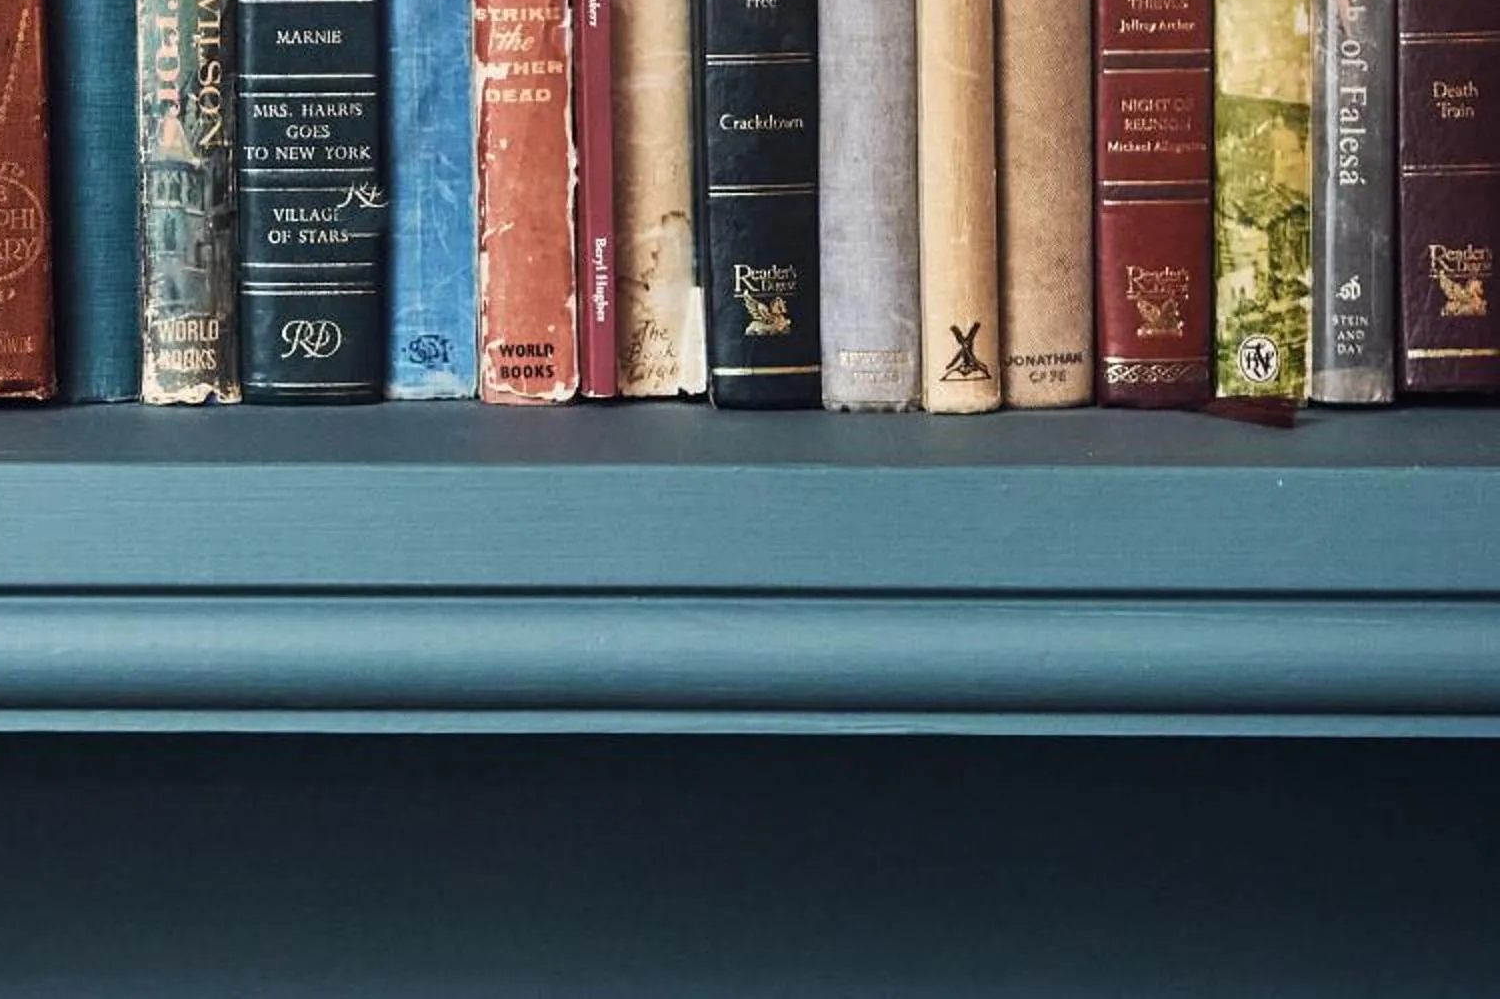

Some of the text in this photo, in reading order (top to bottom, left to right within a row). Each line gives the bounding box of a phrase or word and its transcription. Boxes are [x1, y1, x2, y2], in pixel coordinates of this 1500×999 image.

[276, 31, 342, 44] MARNIE
[485, 89, 551, 102] DEAD
[1433, 82, 1478, 99] Death
[253, 104, 362, 118] MRS. HARRIS
[1437, 102, 1474, 118] Train
[720, 114, 803, 130] Crackdown
[286, 124, 330, 138] GOES
[1339, 86, 1367, 185] Falesá
[244, 145, 372, 160] TO NEW YORK
[268, 230, 349, 244] OF STARS
[592, 238, 606, 272] Beryl
[1332, 315, 1369, 326] STEIN
[157, 319, 219, 341] WORLD
[1337, 330, 1364, 341] AND
[500, 344, 554, 357] WORLD
[1337, 343, 1363, 354] DAY
[1004, 353, 1082, 367] JONATHAN
[501, 365, 555, 378] BOOKS
